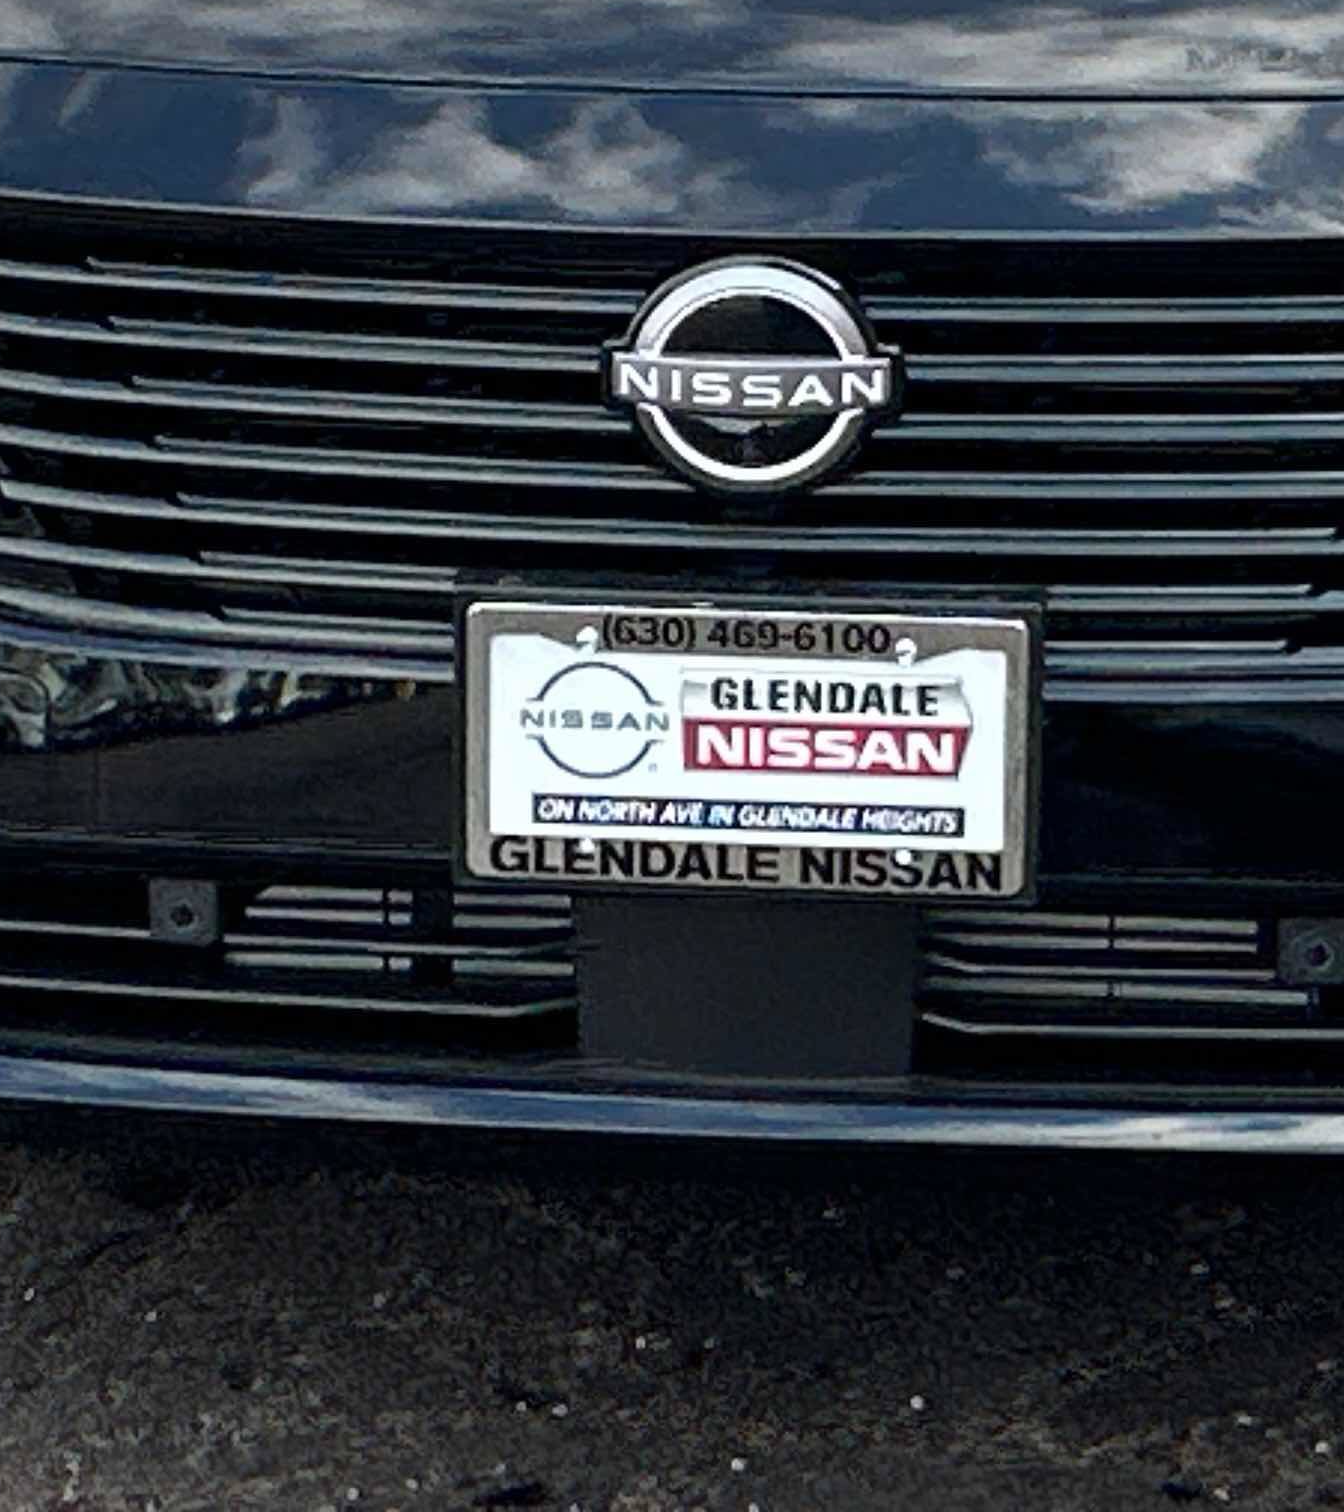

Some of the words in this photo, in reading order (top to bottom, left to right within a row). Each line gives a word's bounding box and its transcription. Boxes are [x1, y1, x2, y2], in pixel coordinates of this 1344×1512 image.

[619, 362, 886, 408] NISSAN
[602, 613, 696, 651] (630)
[707, 619, 892, 655] 469-6100
[710, 677, 940, 717] GLENDALE
[520, 708, 670, 732] NISSAN
[697, 724, 955, 773] NISSAN
[537, 797, 574, 821] ON
[578, 800, 655, 824] NORTH
[659, 802, 704, 825] AVE
[707, 803, 735, 825] IN
[738, 805, 856, 830] GLENDALE
[861, 809, 957, 834] HEIGHTS
[489, 835, 781, 884] GLENDALE
[799, 847, 1003, 892] NISSAN
